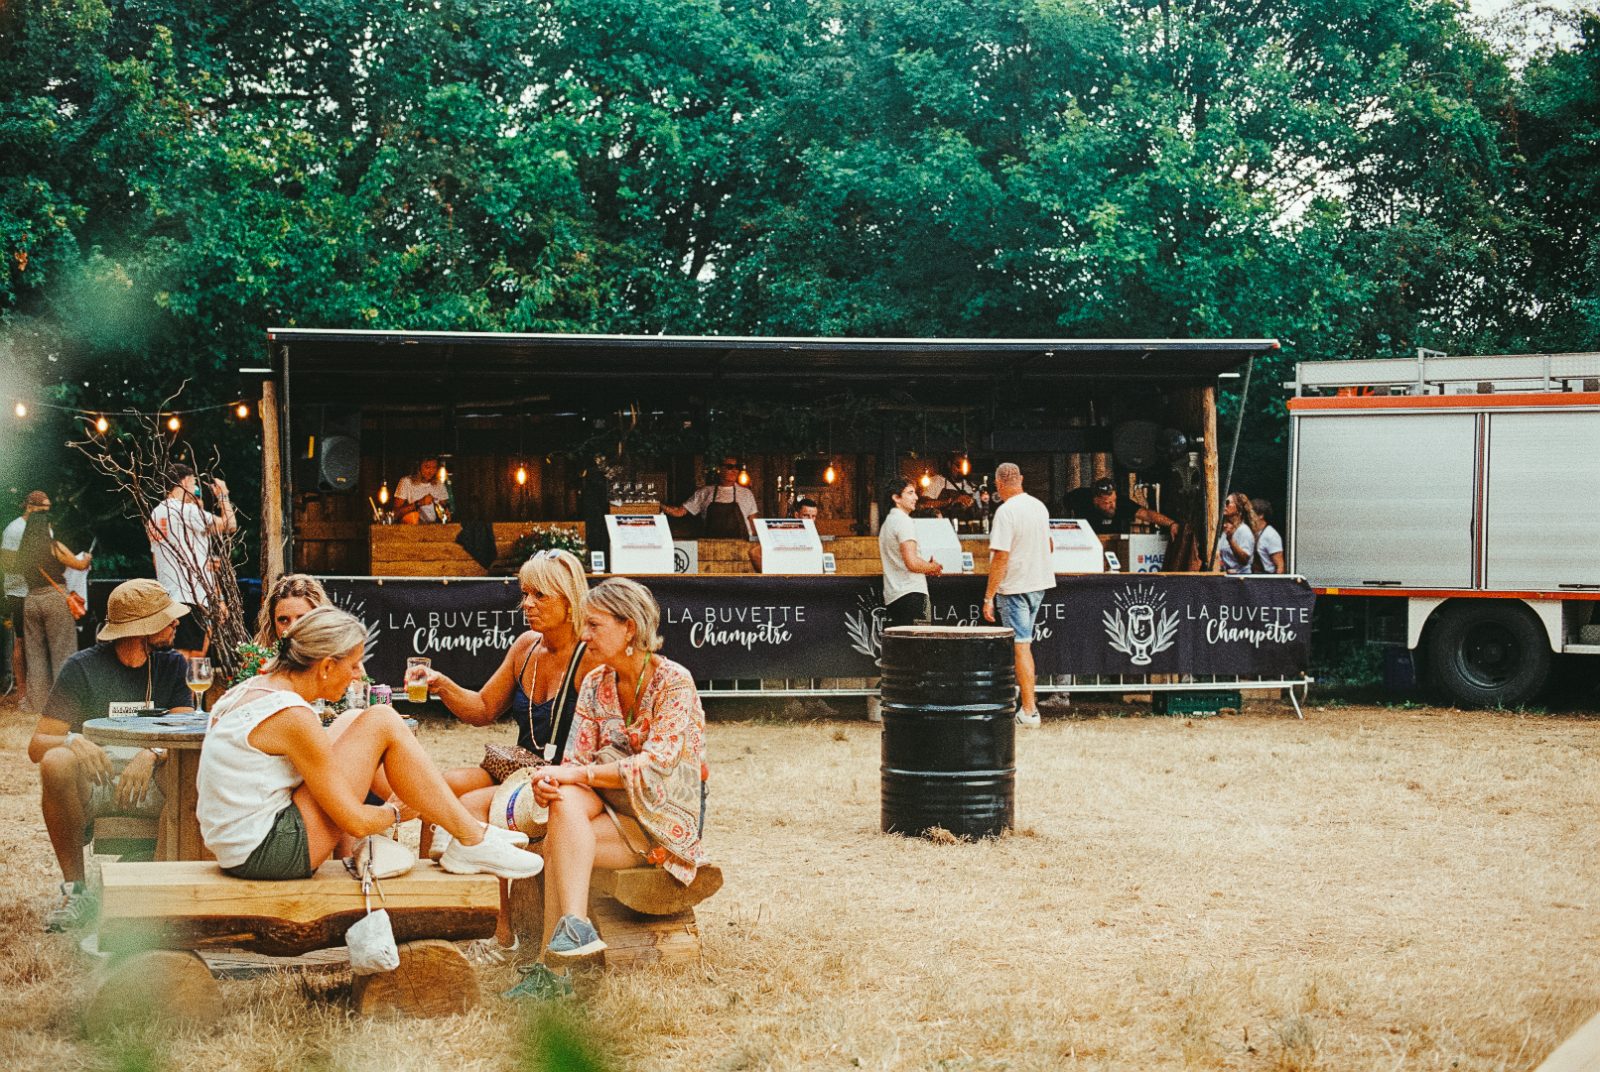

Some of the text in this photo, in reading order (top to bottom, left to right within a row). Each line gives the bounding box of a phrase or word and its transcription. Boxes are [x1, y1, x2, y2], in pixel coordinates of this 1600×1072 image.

[389, 610, 531, 630] LA BUVETTE
[667, 606, 806, 624] LA BUVETTE
[933, 604, 958, 620] LA
[1186, 604, 1309, 623] LA BUVETTE
[412, 626, 516, 657] Champêtre
[689, 621, 792, 651] Champêtre
[1206, 618, 1297, 648] Champêtre
